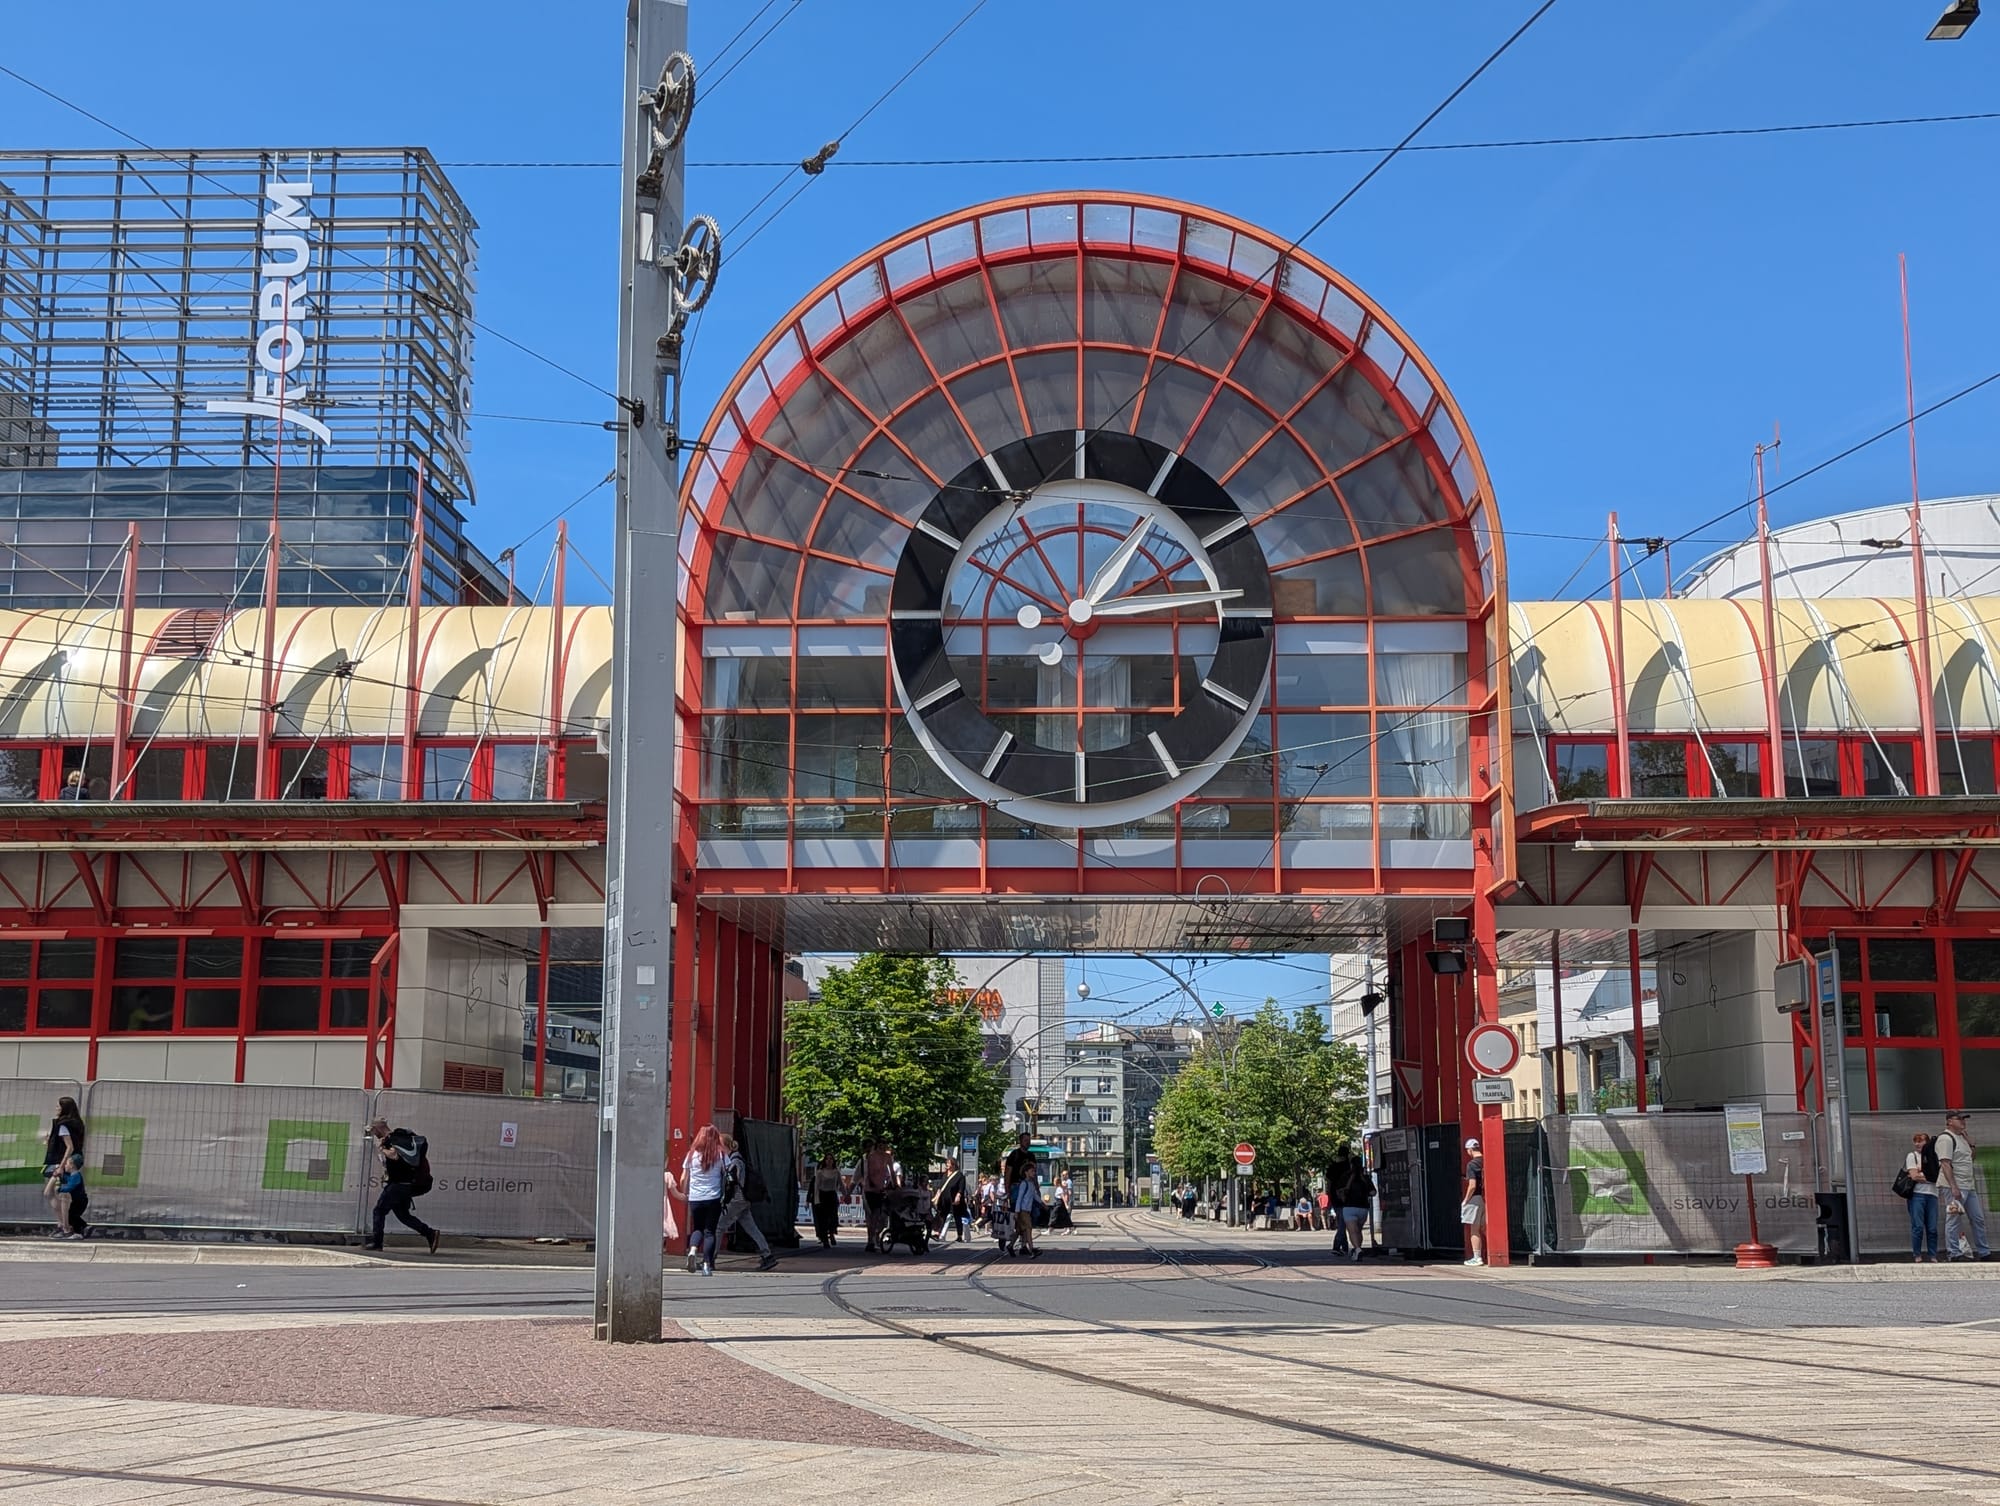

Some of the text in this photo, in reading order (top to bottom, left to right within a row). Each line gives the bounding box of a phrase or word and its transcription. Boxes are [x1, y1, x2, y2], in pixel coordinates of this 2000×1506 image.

[254, 183, 313, 405] FORUM
[439, 1179, 448, 1191] s
[455, 1177, 533, 1193] detailem
[1765, 1195, 1818, 1209] detai
